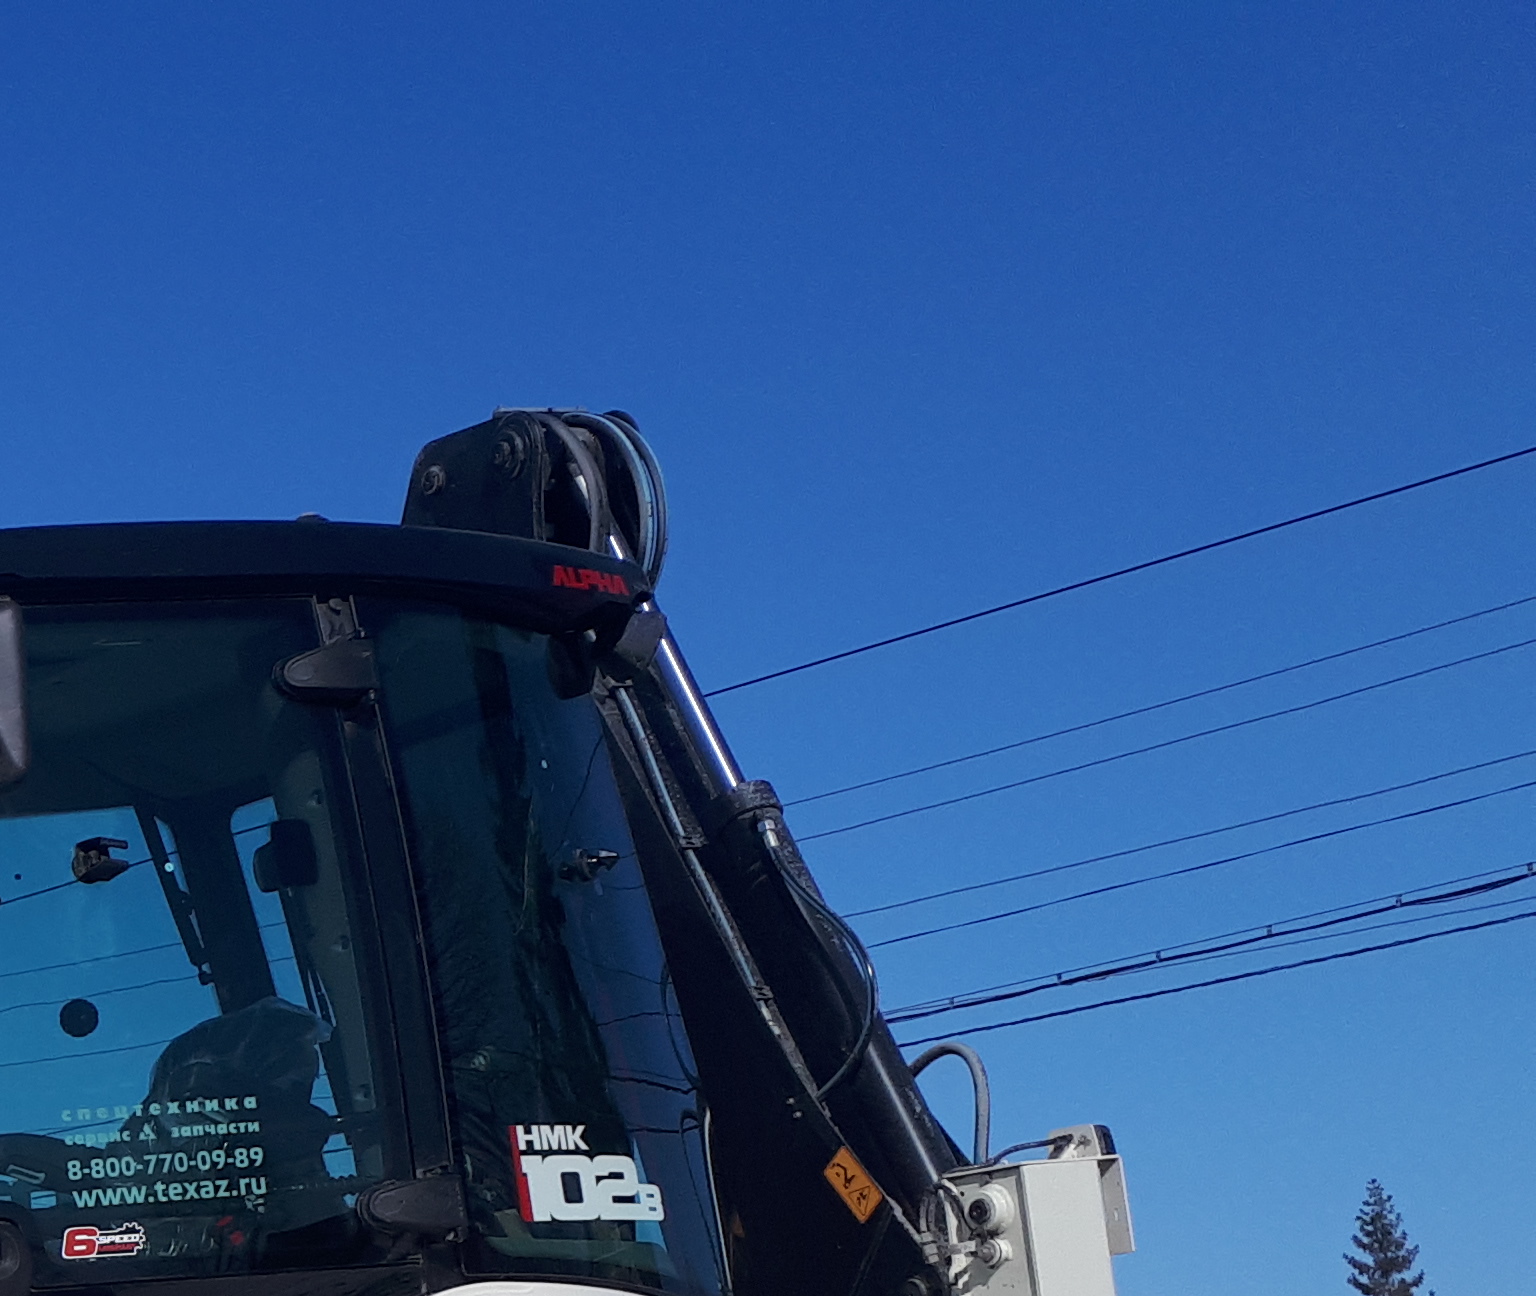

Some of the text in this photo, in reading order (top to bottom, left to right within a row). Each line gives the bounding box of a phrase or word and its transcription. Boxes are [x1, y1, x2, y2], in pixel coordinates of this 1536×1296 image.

[553, 565, 630, 596] ALPHA
[61, 1096, 257, 1122] спецтехника
[64, 1121, 260, 1148] сервис запчасти
[516, 1125, 590, 1150] HMK
[67, 1147, 264, 1181] 8-800-770-09-89
[72, 1176, 267, 1209] www.texaz.ru
[64, 1228, 98, 1257] 6
